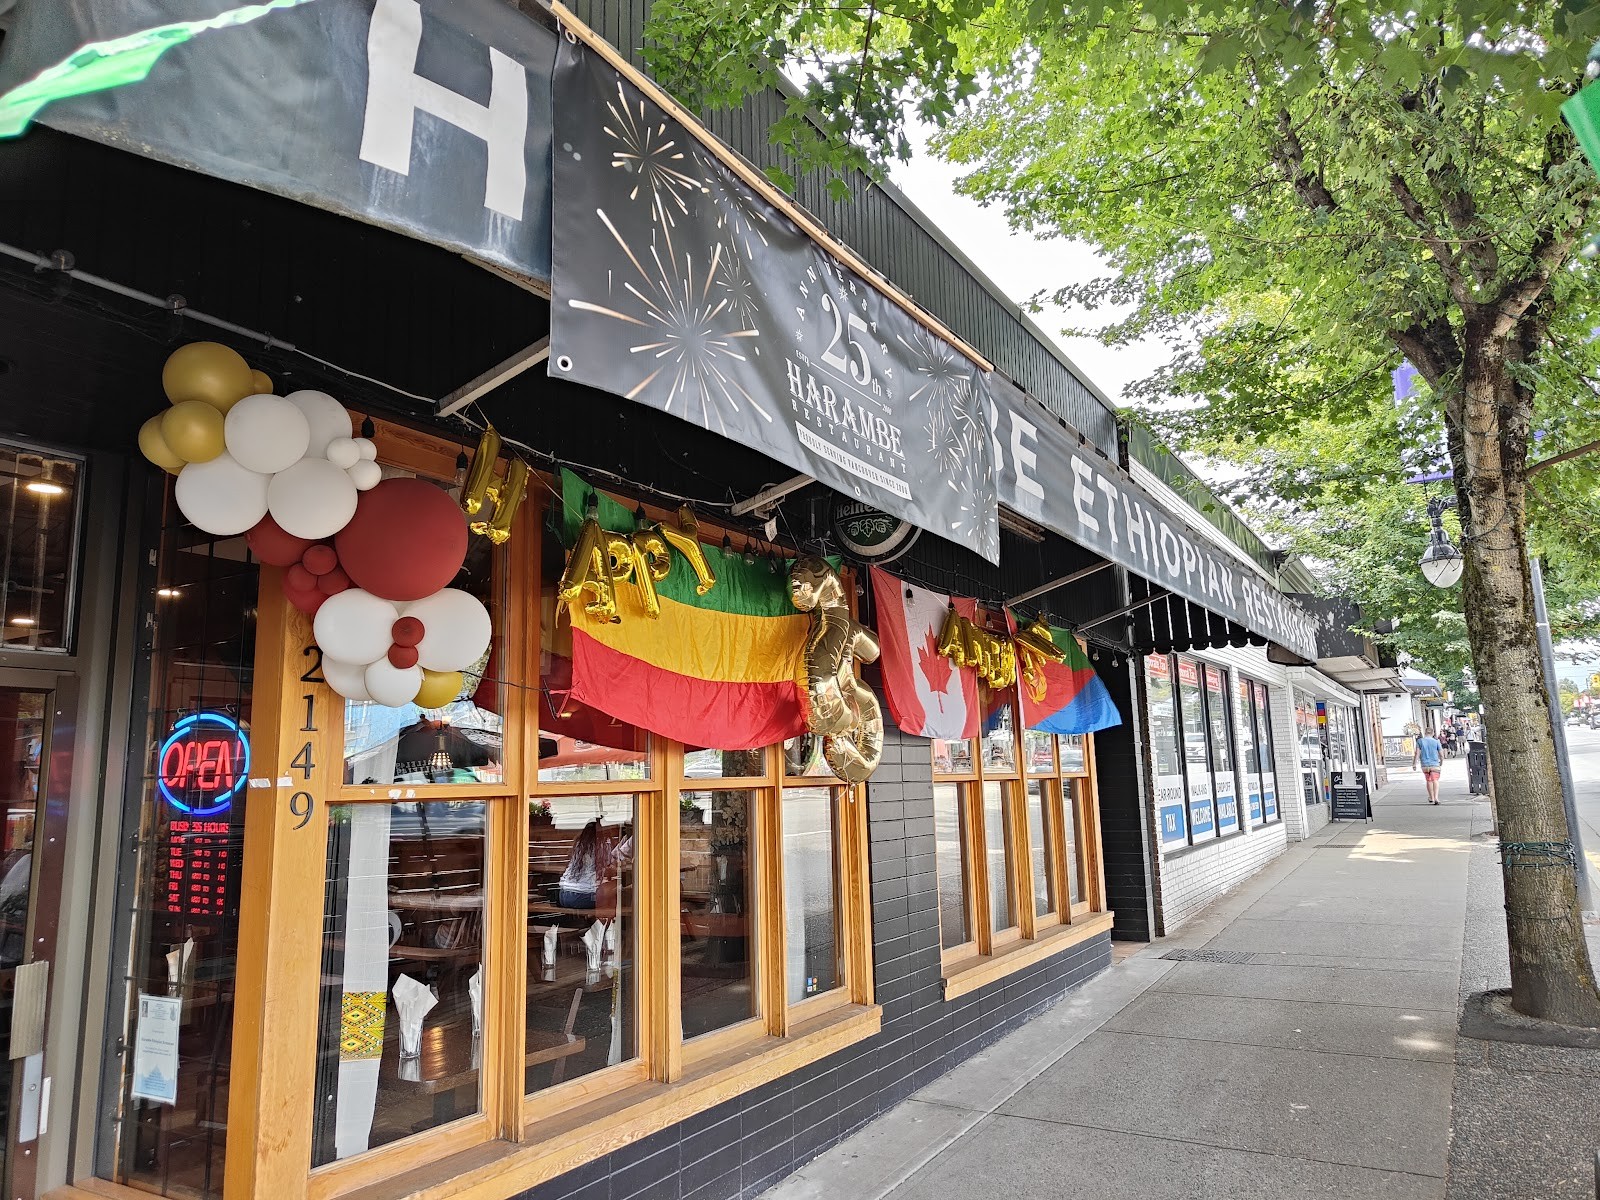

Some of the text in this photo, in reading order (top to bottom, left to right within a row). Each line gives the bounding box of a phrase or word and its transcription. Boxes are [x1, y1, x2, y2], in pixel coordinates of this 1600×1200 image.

[785, 357, 906, 461] HARAMBE
[791, 398, 907, 474] RESTAURANT
[798, 428, 822, 451] PROUDLY
[823, 445, 847, 465] SERVING
[847, 456, 879, 480] VANCOUVER
[880, 474, 895, 489] SINCE
[836, 500, 876, 520] Heine
[1070, 454, 1237, 610] ETHIOPIAN
[1241, 575, 1317, 656] RESTAURANT
[161, 740, 242, 789] OPEN
[203, 822, 229, 834] HOURS
[1165, 812, 1177, 833] TAX
